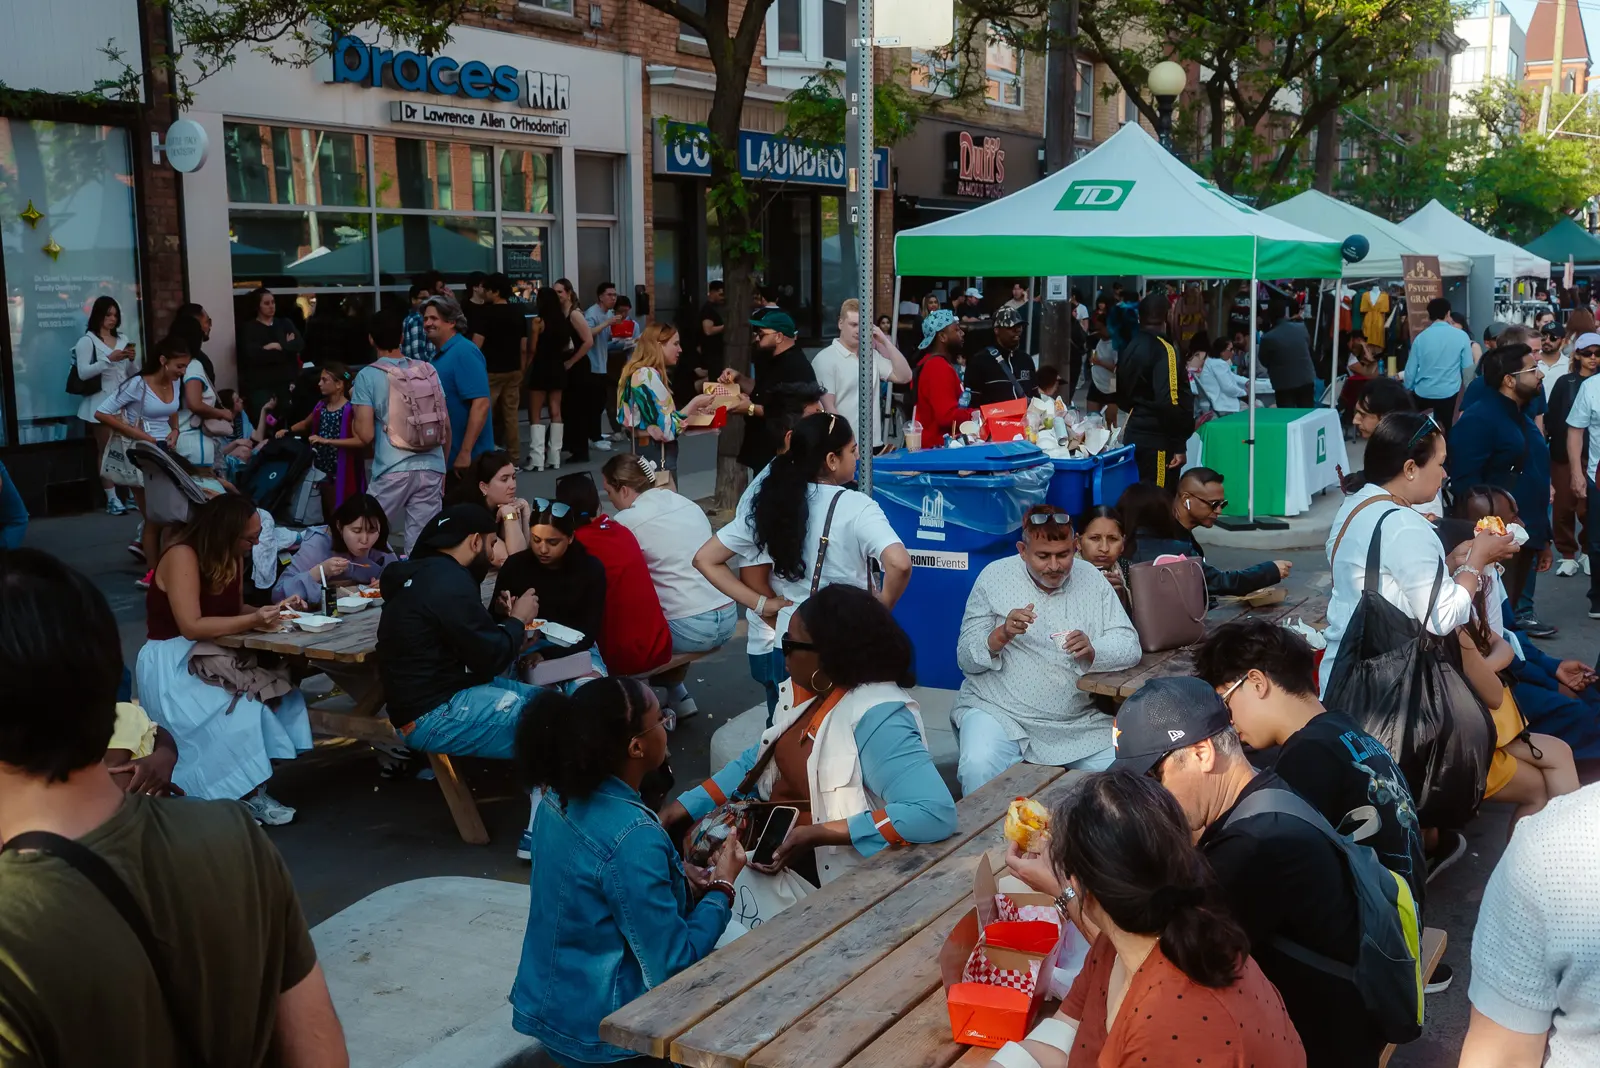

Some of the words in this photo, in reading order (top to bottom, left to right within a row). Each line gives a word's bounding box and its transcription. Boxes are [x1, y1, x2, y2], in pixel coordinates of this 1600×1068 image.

[333, 27, 520, 102] braces
[404, 103, 418, 119] Dr
[423, 106, 475, 125] Lawrence
[480, 112, 506, 128] Allen
[510, 117, 568, 135] Orthodontist
[746, 139, 882, 181] LAUNDROT
[959, 131, 1005, 183] Duff's
[957, 181, 983, 197] FAMOUS
[1074, 185, 1123, 205] TD
[919, 515, 945, 529] TORONTO
[936, 556, 966, 569] Events
